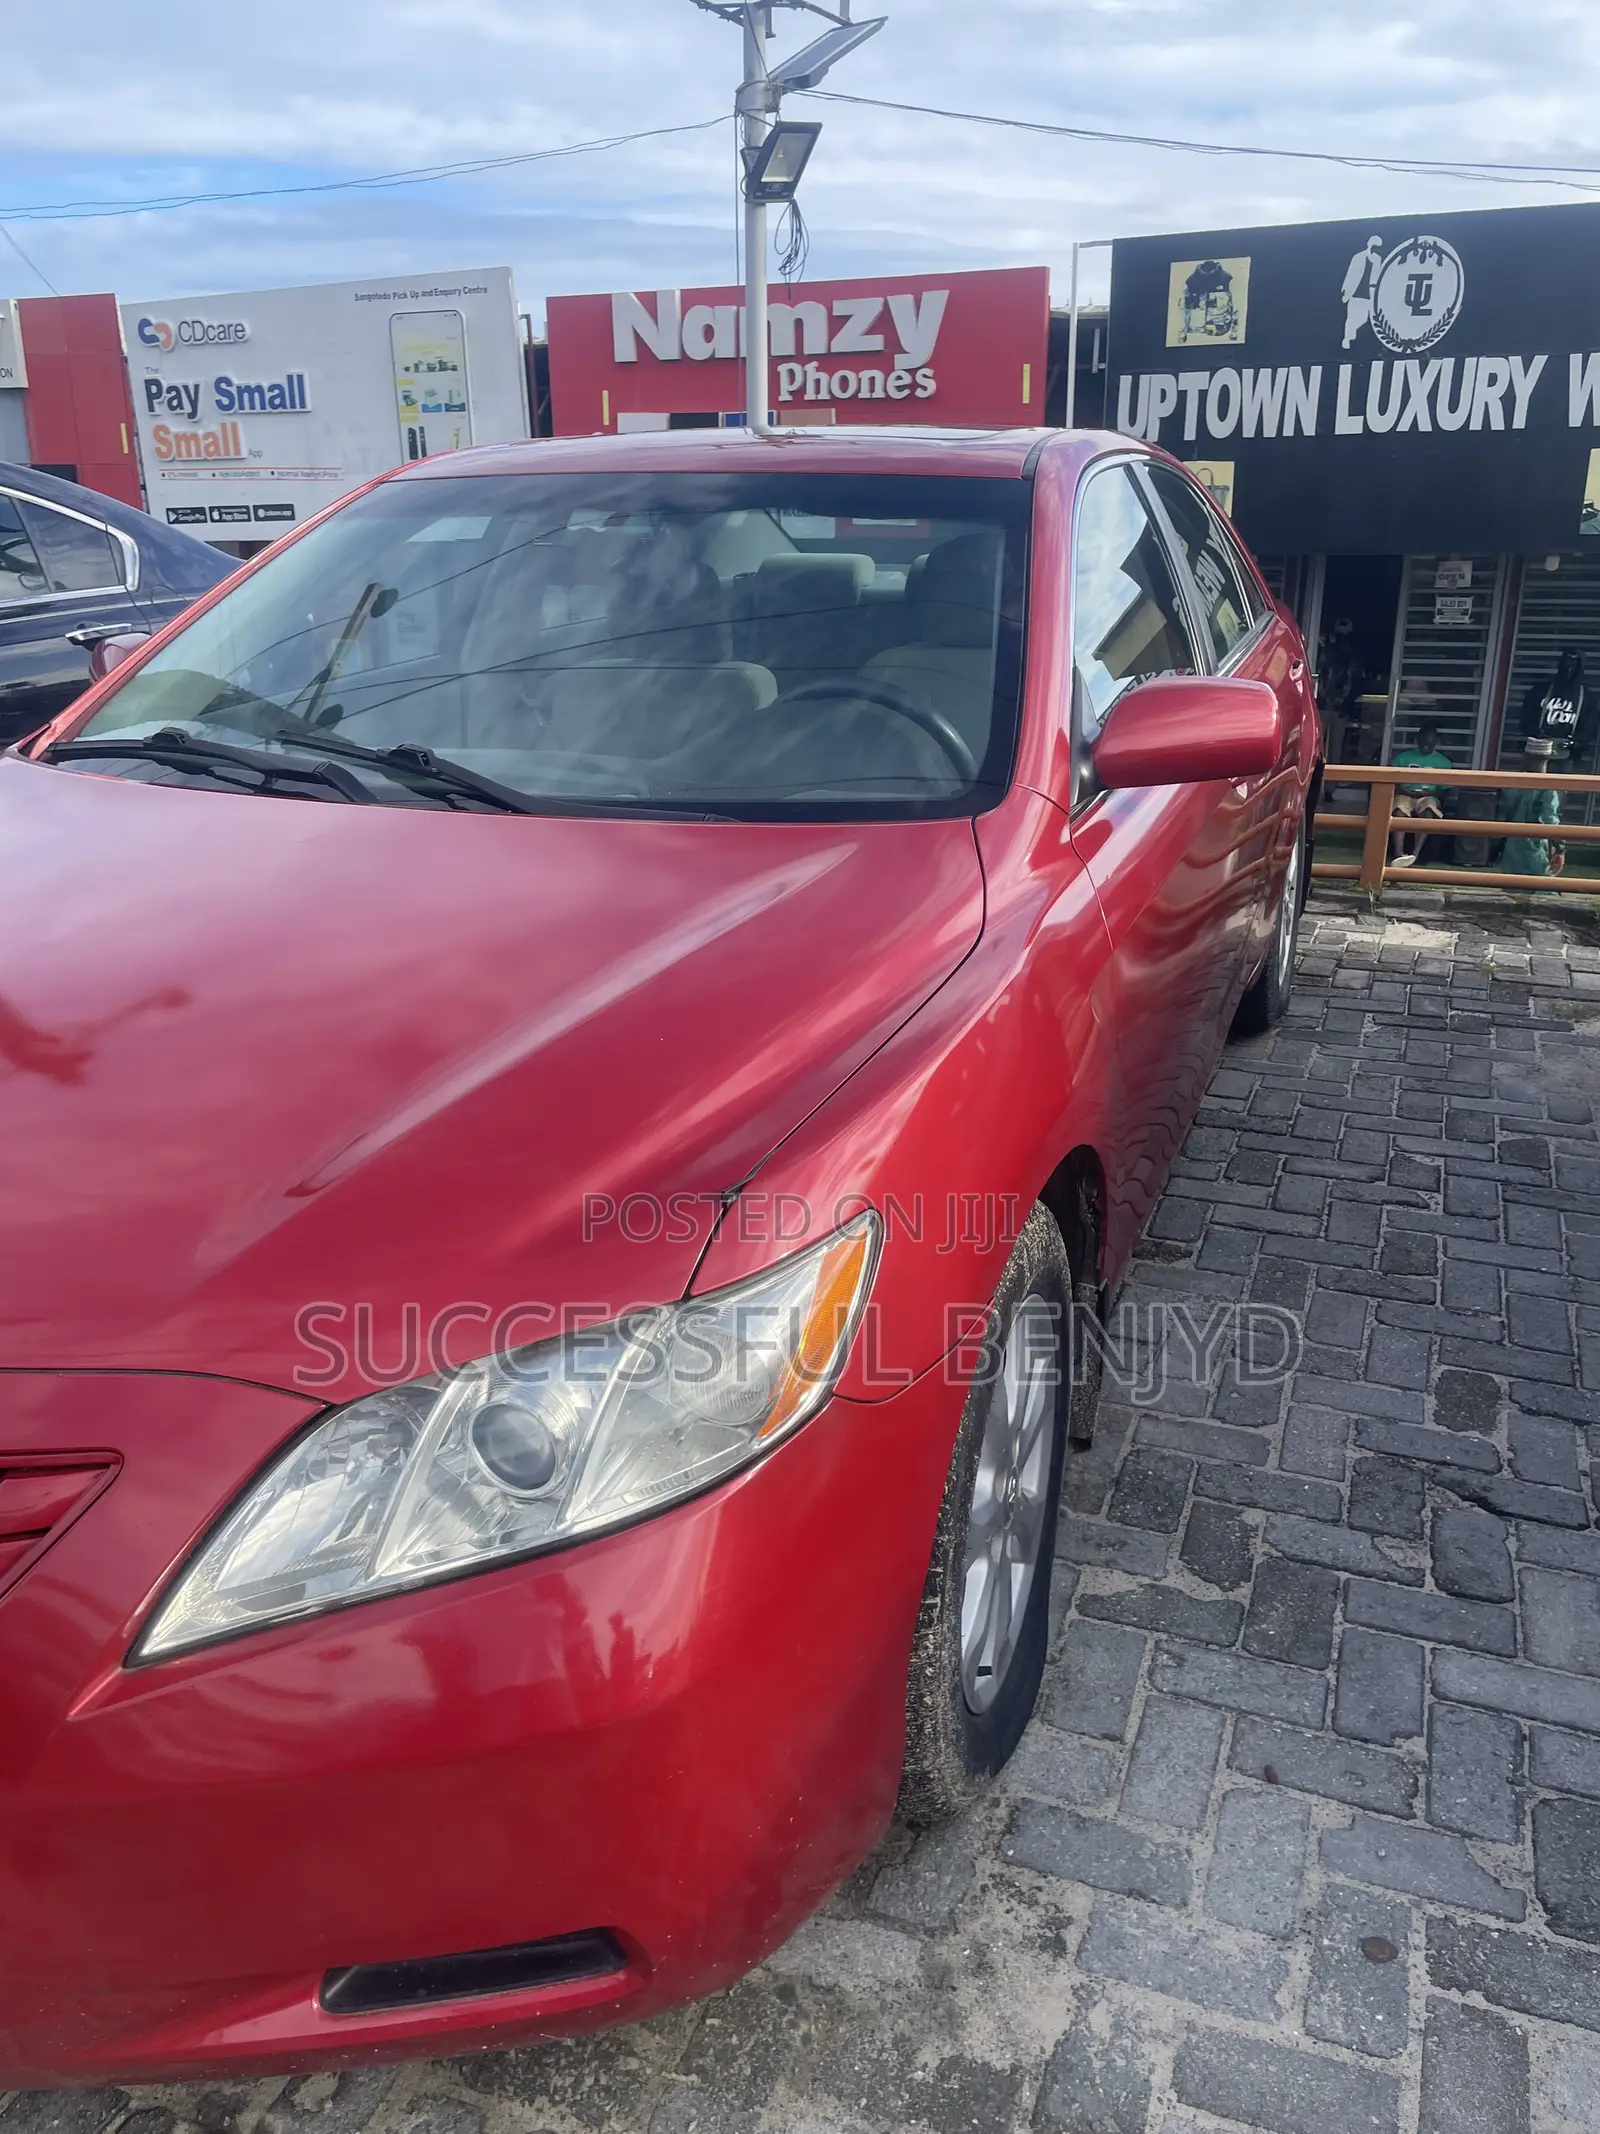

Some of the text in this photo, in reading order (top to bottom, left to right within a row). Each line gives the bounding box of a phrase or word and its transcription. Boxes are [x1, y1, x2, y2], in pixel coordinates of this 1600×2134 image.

[392, 291, 409, 300] Pick
[409, 290, 420, 300] Up
[421, 289, 433, 297] and
[434, 287, 461, 297] Enquiry
[463, 286, 488, 295] Centre
[178, 320, 247, 343] CDcare
[611, 289, 949, 371] Namzy
[144, 374, 307, 420] Pay Small
[777, 361, 937, 402] Phones
[1117, 365, 1323, 443] UPTOWN
[1334, 354, 1549, 436] LUXURY
[153, 421, 241, 459] Small
[248, 449, 263, 458] App
